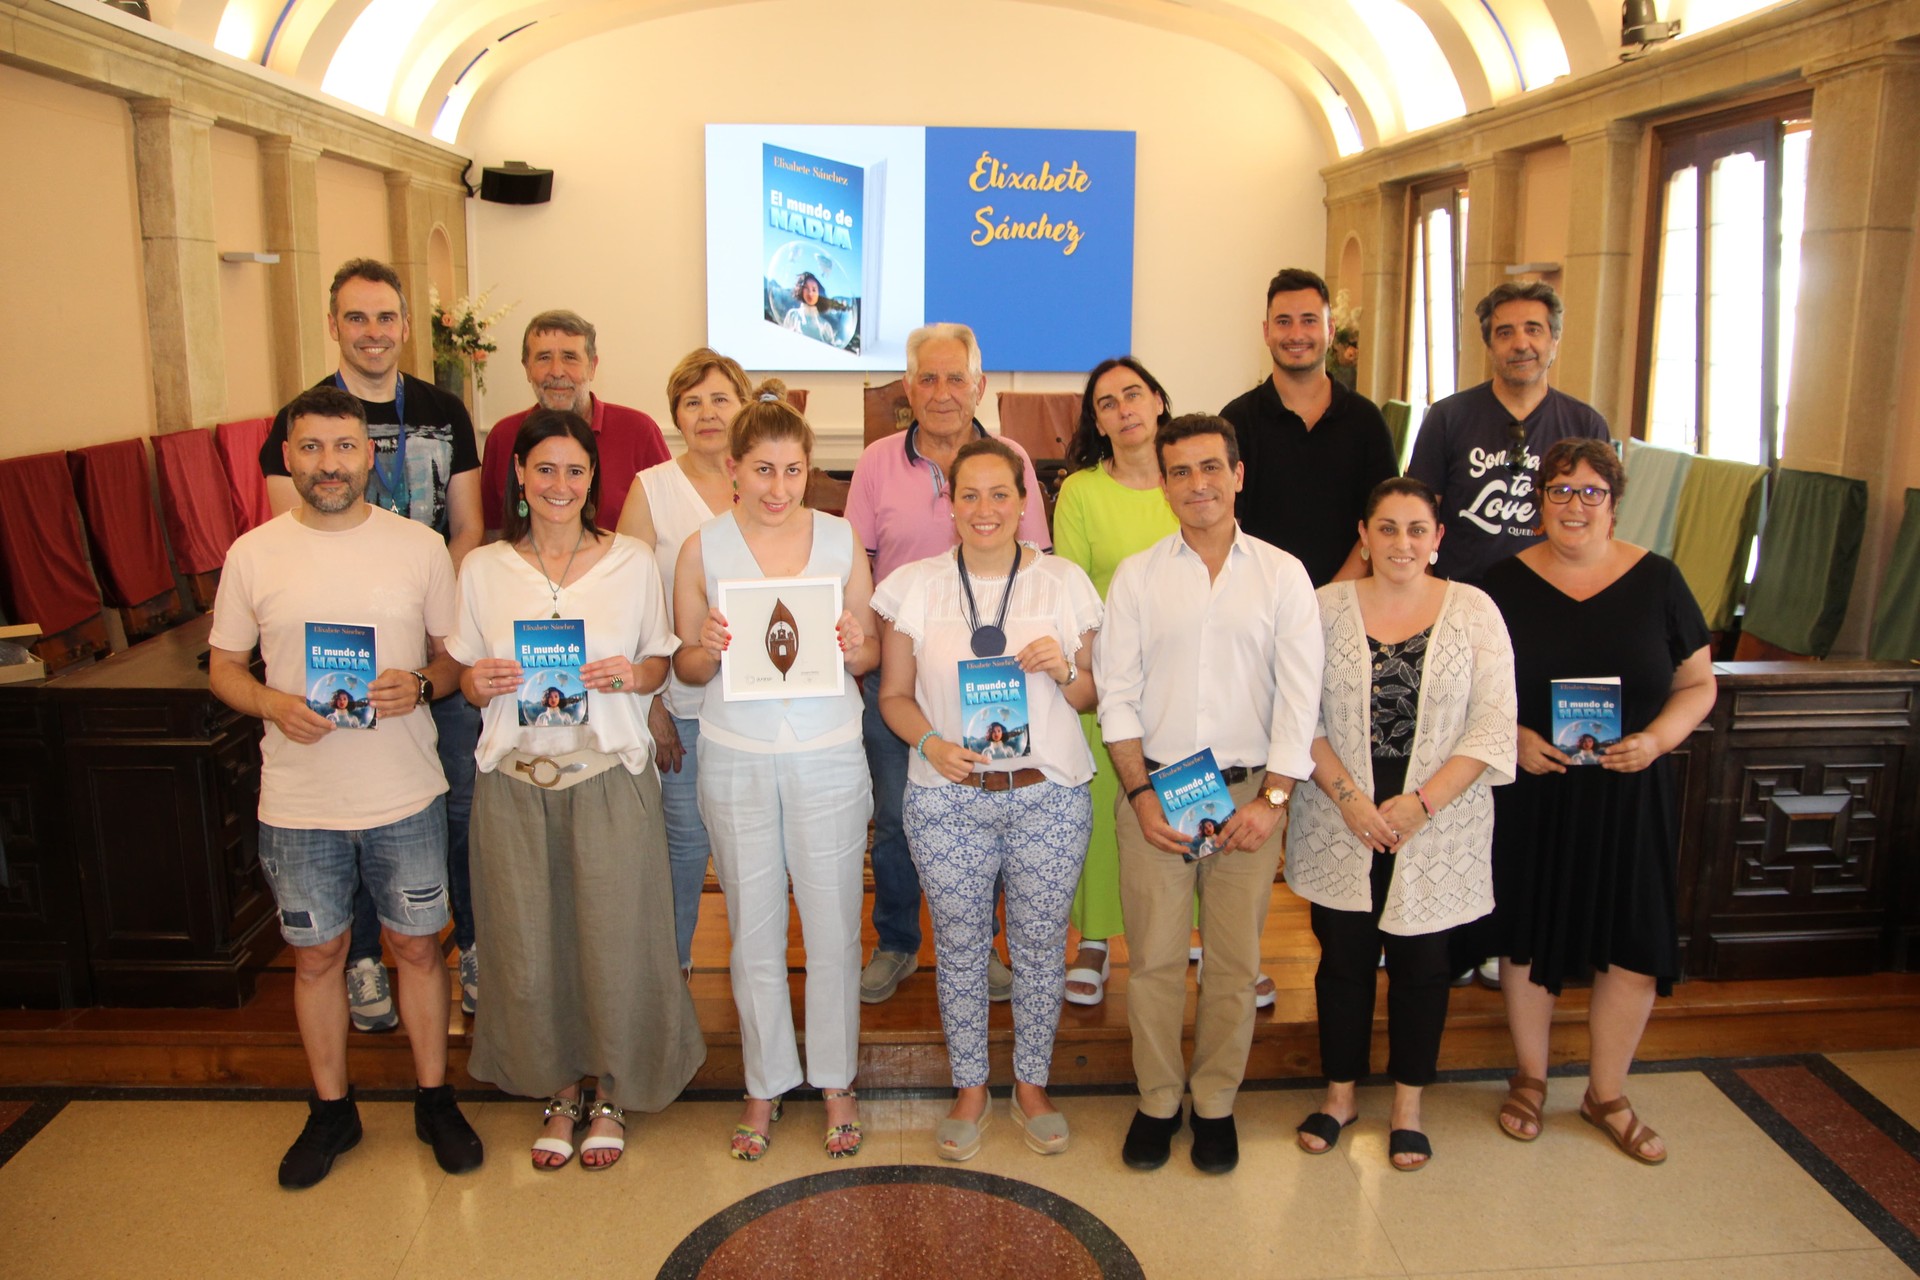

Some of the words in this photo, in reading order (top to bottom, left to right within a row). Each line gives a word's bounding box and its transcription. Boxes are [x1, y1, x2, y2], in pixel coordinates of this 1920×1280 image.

[813, 167, 848, 186] Sánchez
[771, 190, 782, 207] El
[787, 198, 831, 221] mundo
[835, 209, 853, 227] de
[770, 206, 852, 250] NADIA
[971, 205, 1085, 256] Sánchez
[1510, 472, 1534, 497] to
[1458, 479, 1536, 535] Love
[313, 646, 321, 655] El
[324, 648, 356, 657] mundo
[358, 649, 370, 658] de
[522, 645, 531, 654] El
[534, 644, 565, 654] mundo
[568, 643, 580, 653] de
[312, 656, 370, 671] NADIA
[522, 654, 581, 668] NADIA
[966, 683, 974, 692] El
[977, 680, 1006, 691] mundo
[1009, 679, 1020, 688] de
[967, 689, 1021, 705] NADIA
[1558, 708, 1615, 719] NADIA
[1164, 790, 1174, 801] El
[1175, 778, 1203, 796] mundo
[1204, 772, 1216, 782] de
[1167, 780, 1221, 812] NADIA
